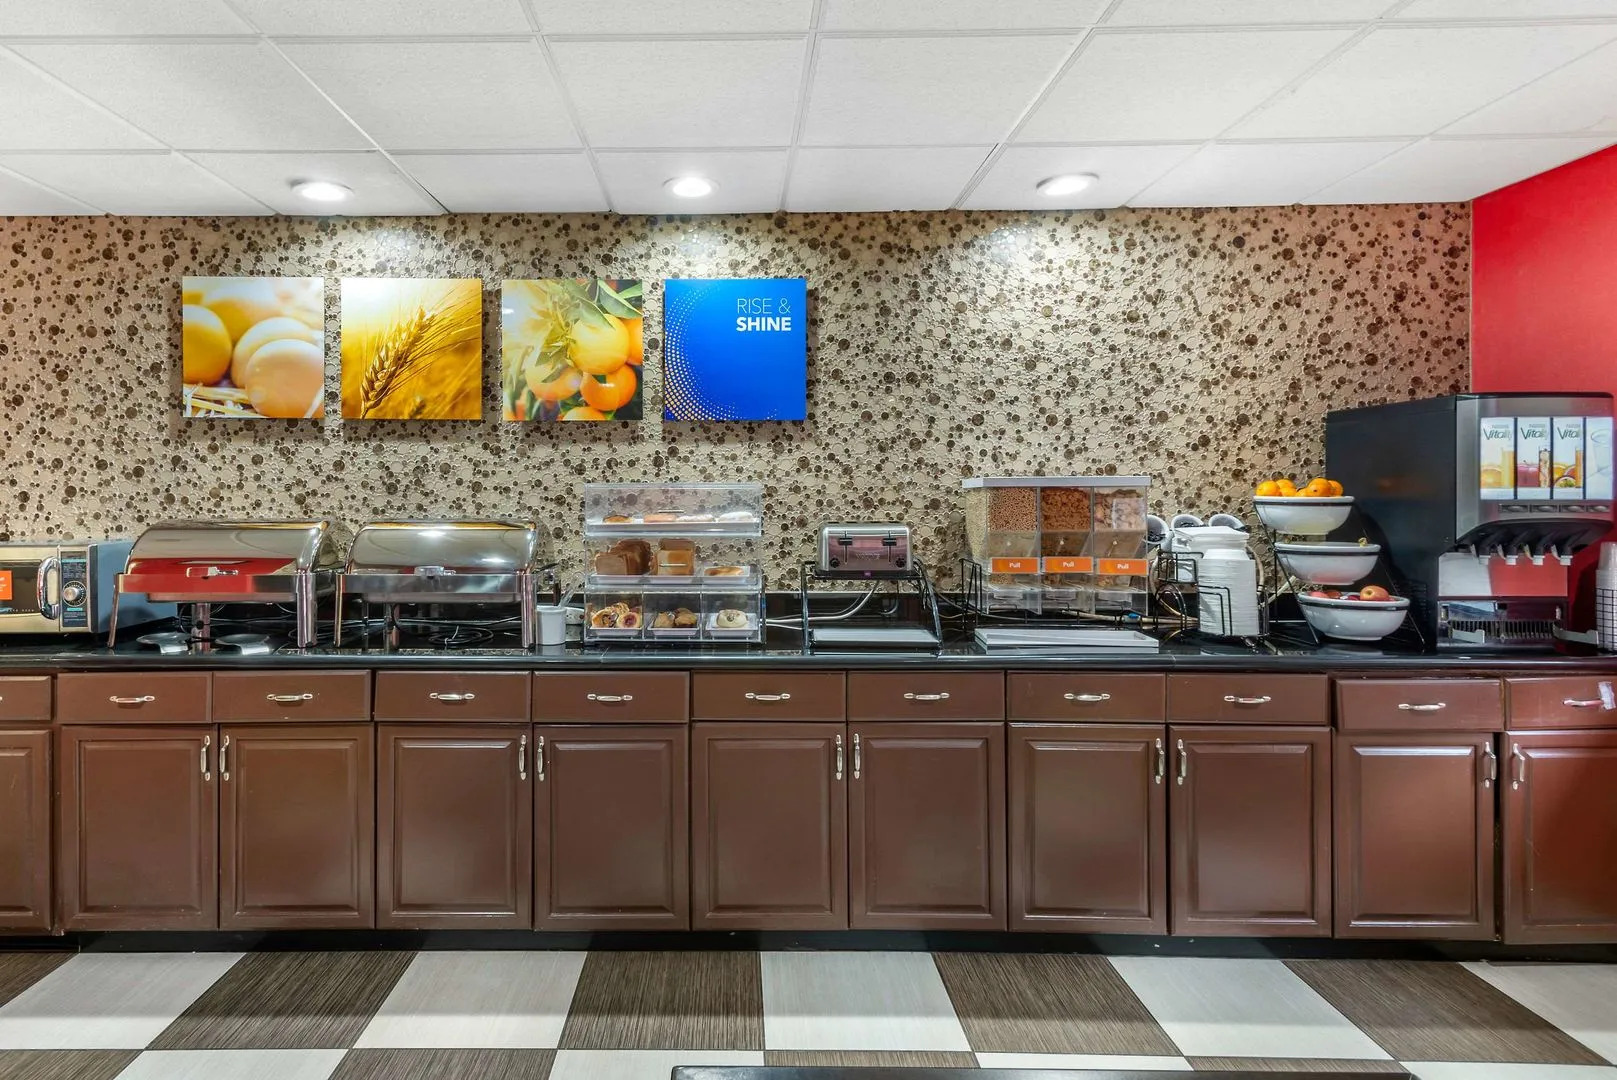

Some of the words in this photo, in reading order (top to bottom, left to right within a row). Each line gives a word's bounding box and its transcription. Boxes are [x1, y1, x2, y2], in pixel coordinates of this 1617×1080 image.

[737, 297, 772, 314] RISE
[778, 297, 791, 314] &
[736, 316, 792, 332] SHINE
